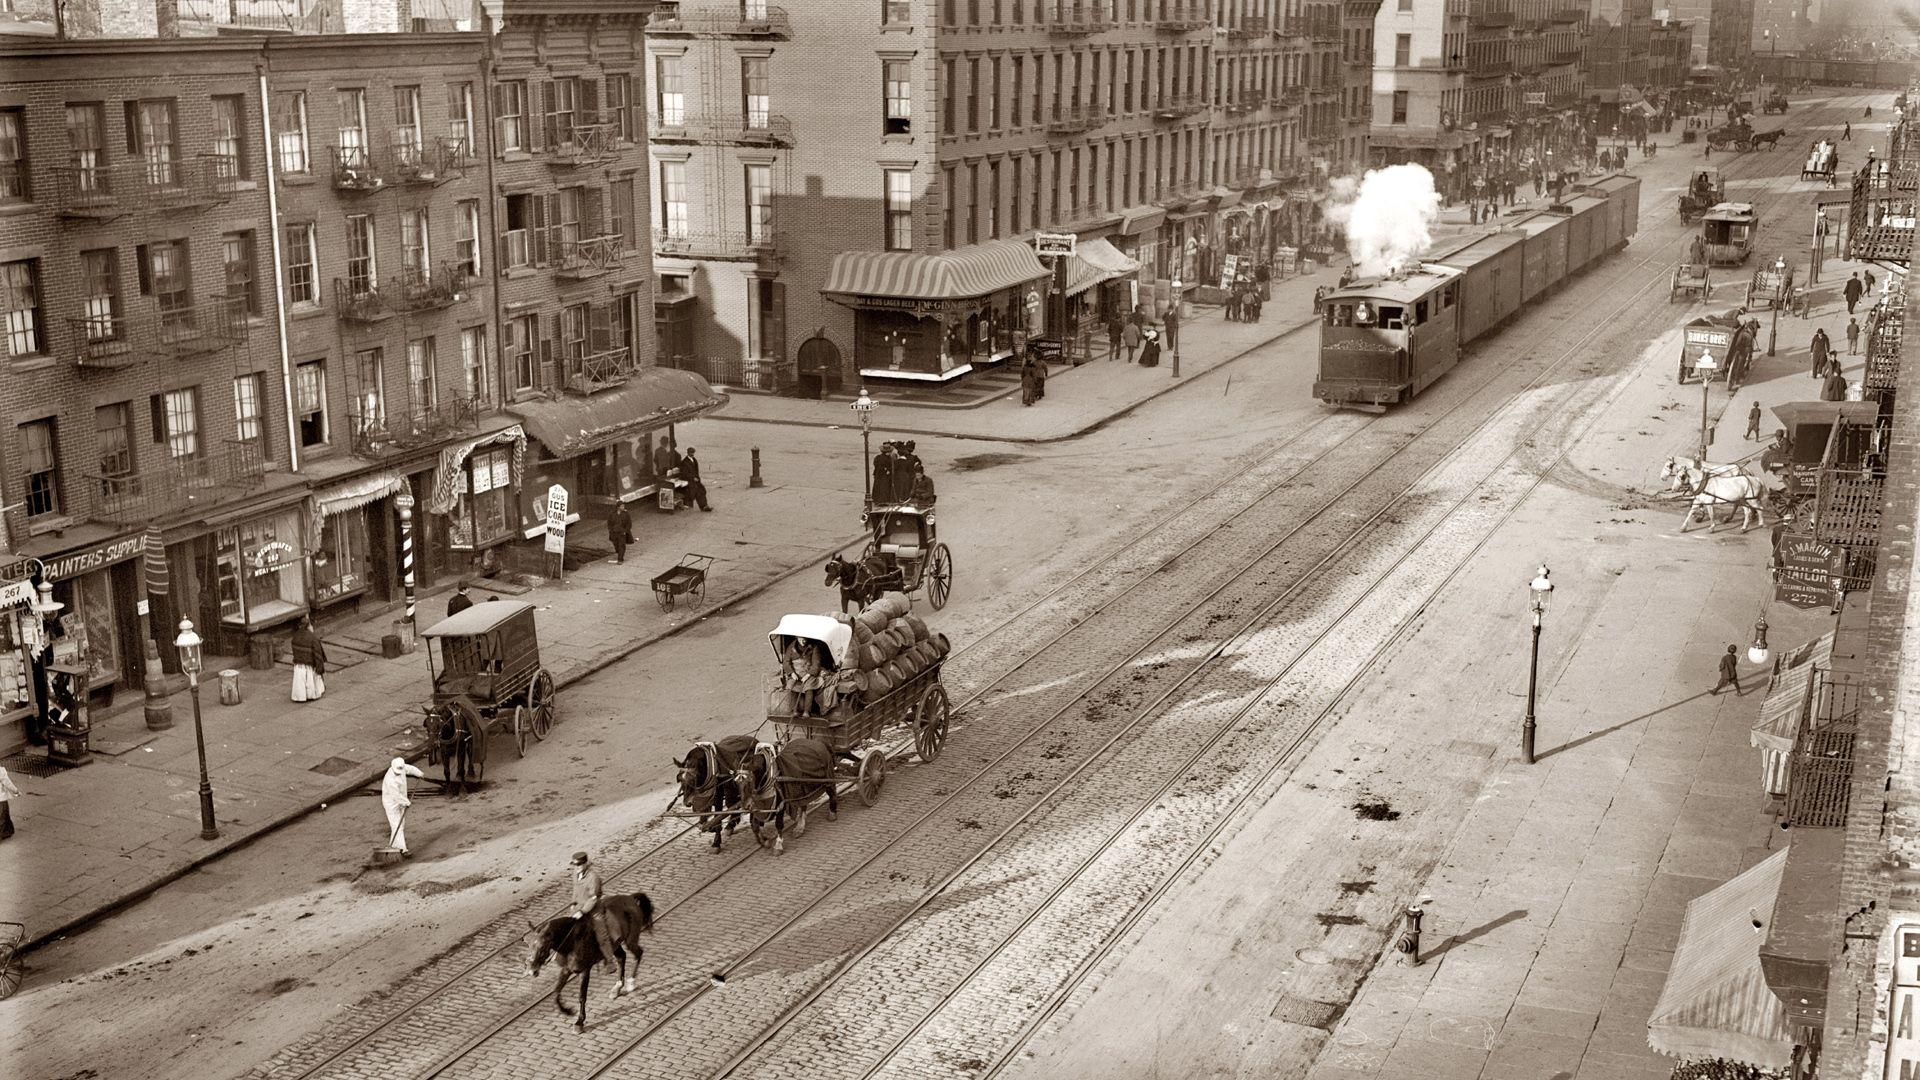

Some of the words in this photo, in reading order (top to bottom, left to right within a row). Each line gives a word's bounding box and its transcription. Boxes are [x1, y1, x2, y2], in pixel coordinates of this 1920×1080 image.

[549, 500, 566, 512] ICE
[547, 510, 565, 522] COAL
[546, 526, 565, 538] WOOD
[45, 549, 104, 579] PAINTERS
[105, 534, 148, 562] SUPPLIE
[1786, 565, 1828, 582] TAILOR
[4, 586, 21, 599] 267
[656, 582, 671, 592] ICE
[1791, 593, 1817, 604] 272
